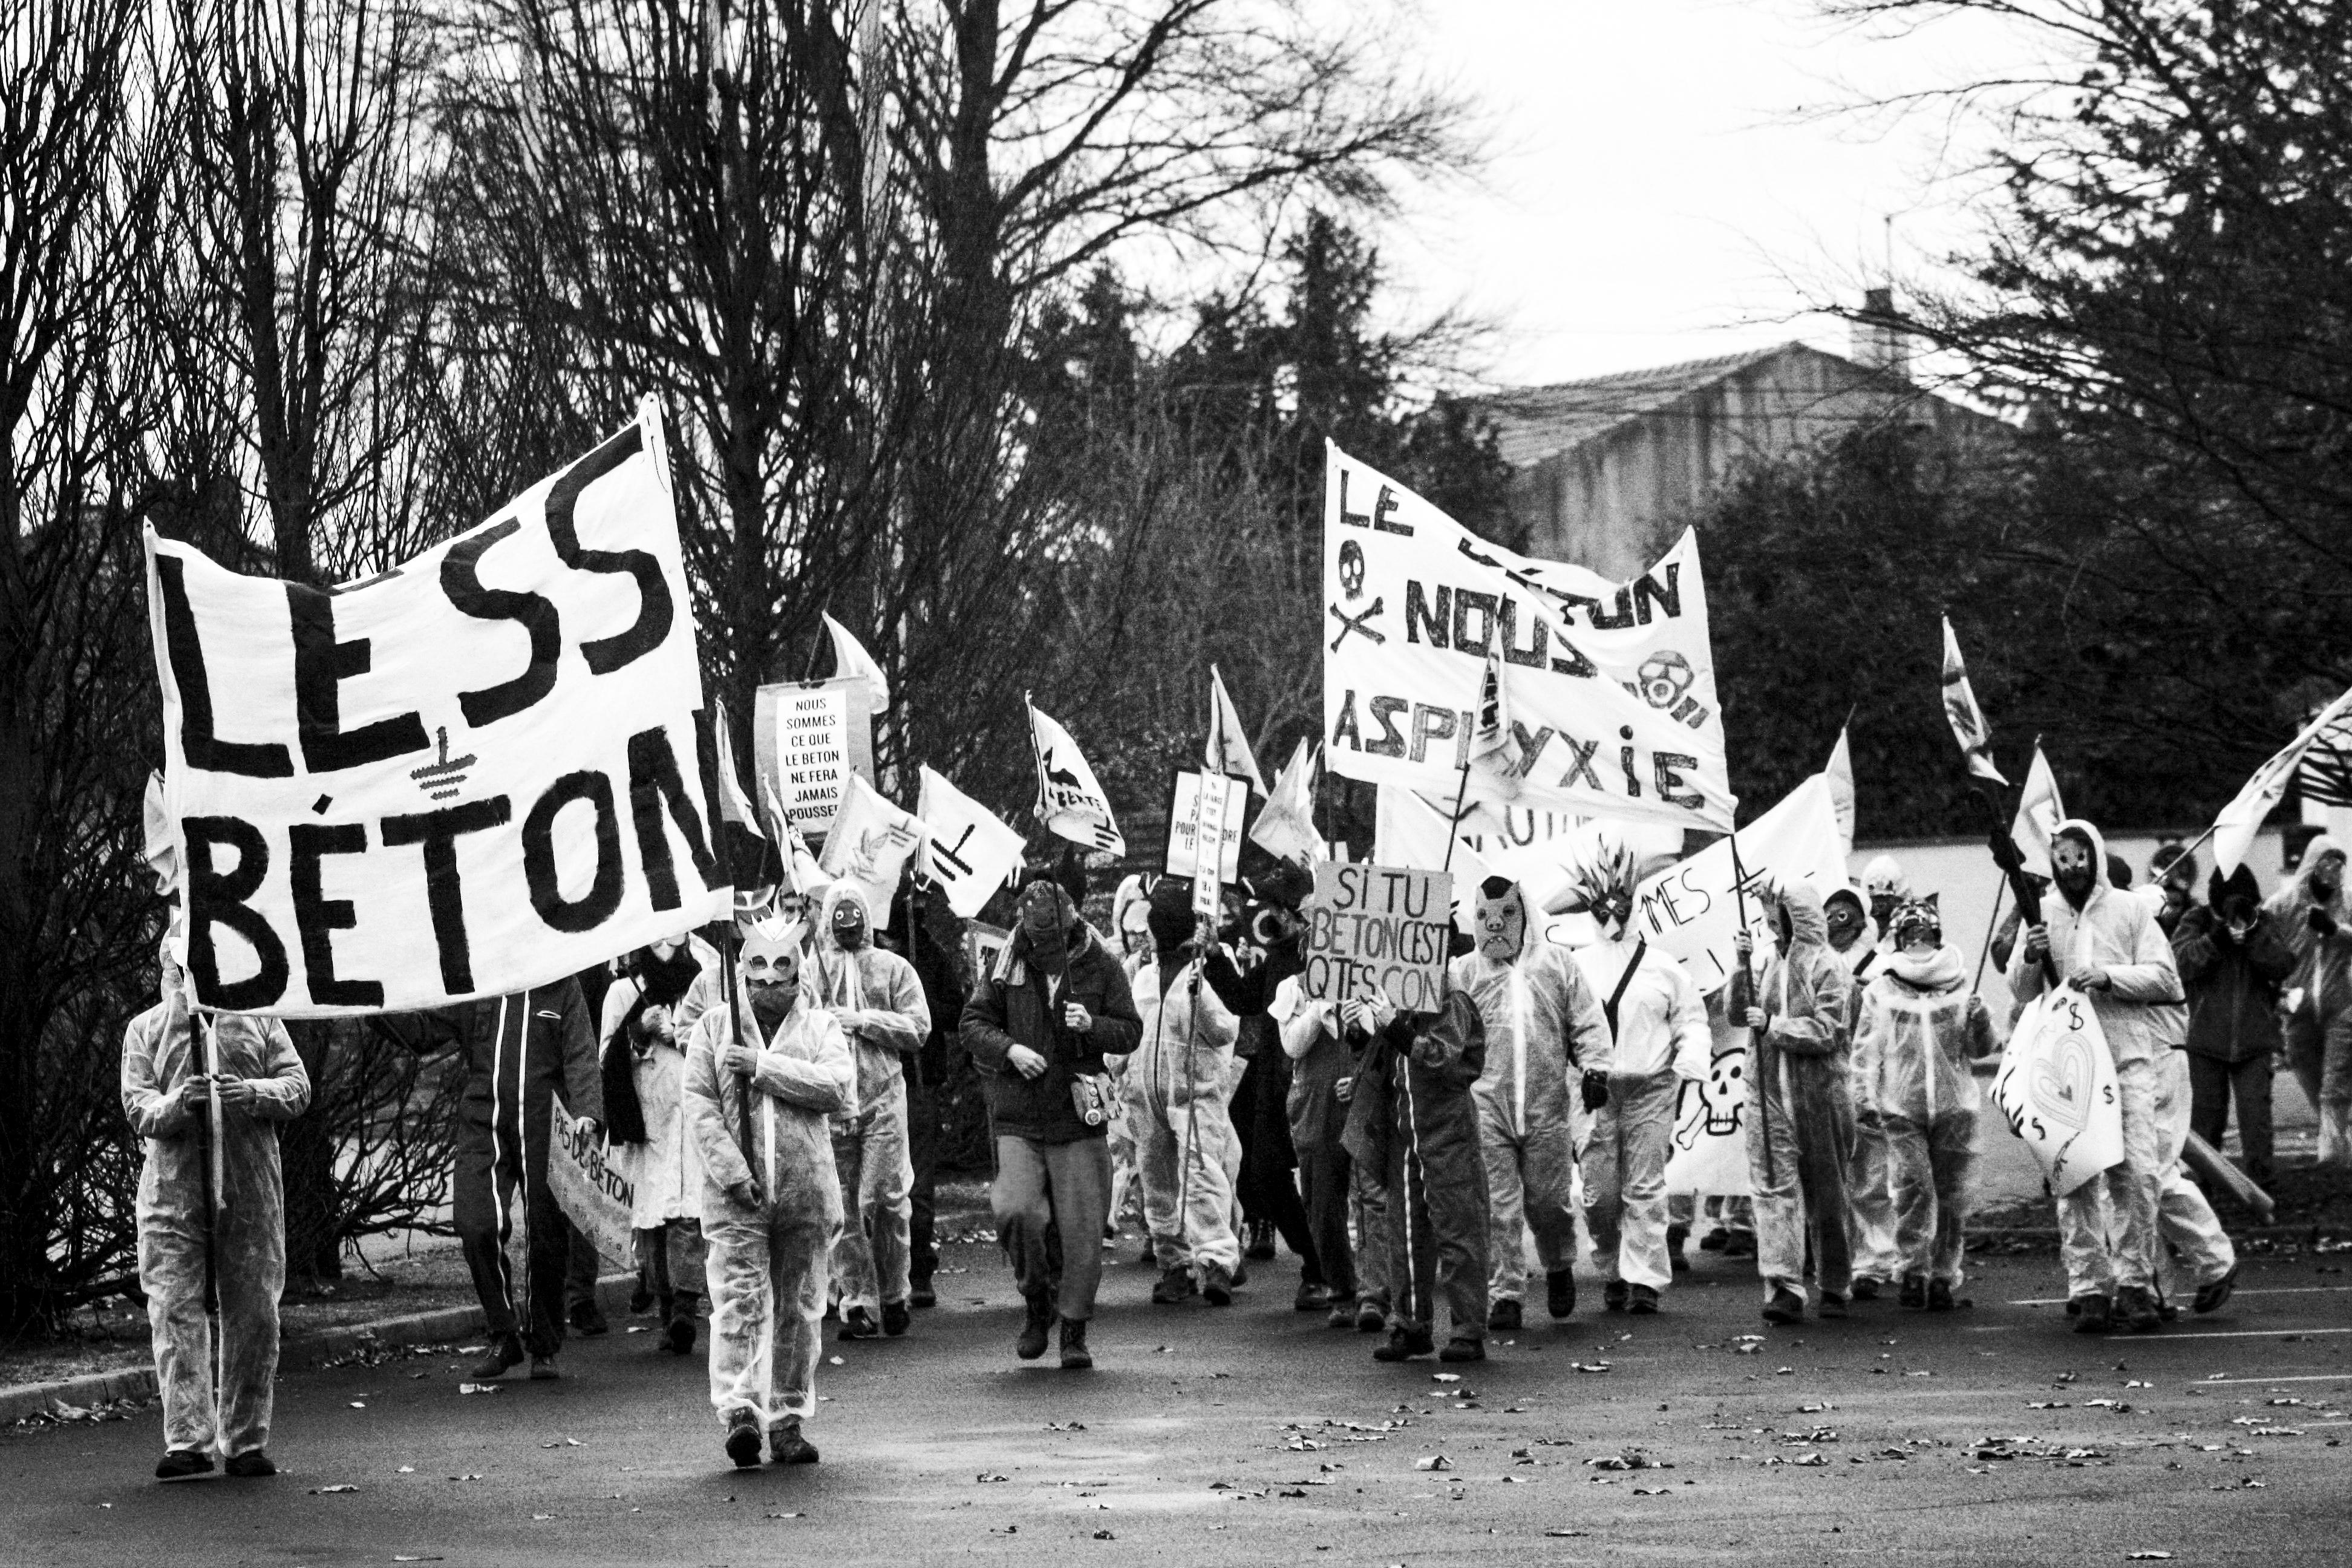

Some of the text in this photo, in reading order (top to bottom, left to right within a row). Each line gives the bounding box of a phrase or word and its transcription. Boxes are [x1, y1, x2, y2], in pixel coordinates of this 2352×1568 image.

[1341, 471, 1414, 537] LE
[155, 422, 675, 778] LESS
[1406, 580, 1598, 678] NOUS
[796, 699, 826, 711] NOUS
[787, 714, 835, 730] SOMMES
[791, 733, 831, 747] CE QUE
[786, 750, 840, 766] LE BETON
[791, 769, 838, 784] NE FERA
[795, 787, 838, 802] JAMAIS
[789, 805, 838, 821] POUSSE
[181, 709, 729, 1009] BÉTON
[1381, 872, 1429, 918] TU
[1310, 907, 1399, 961] BETON
[1381, 966, 1448, 1010] CON
